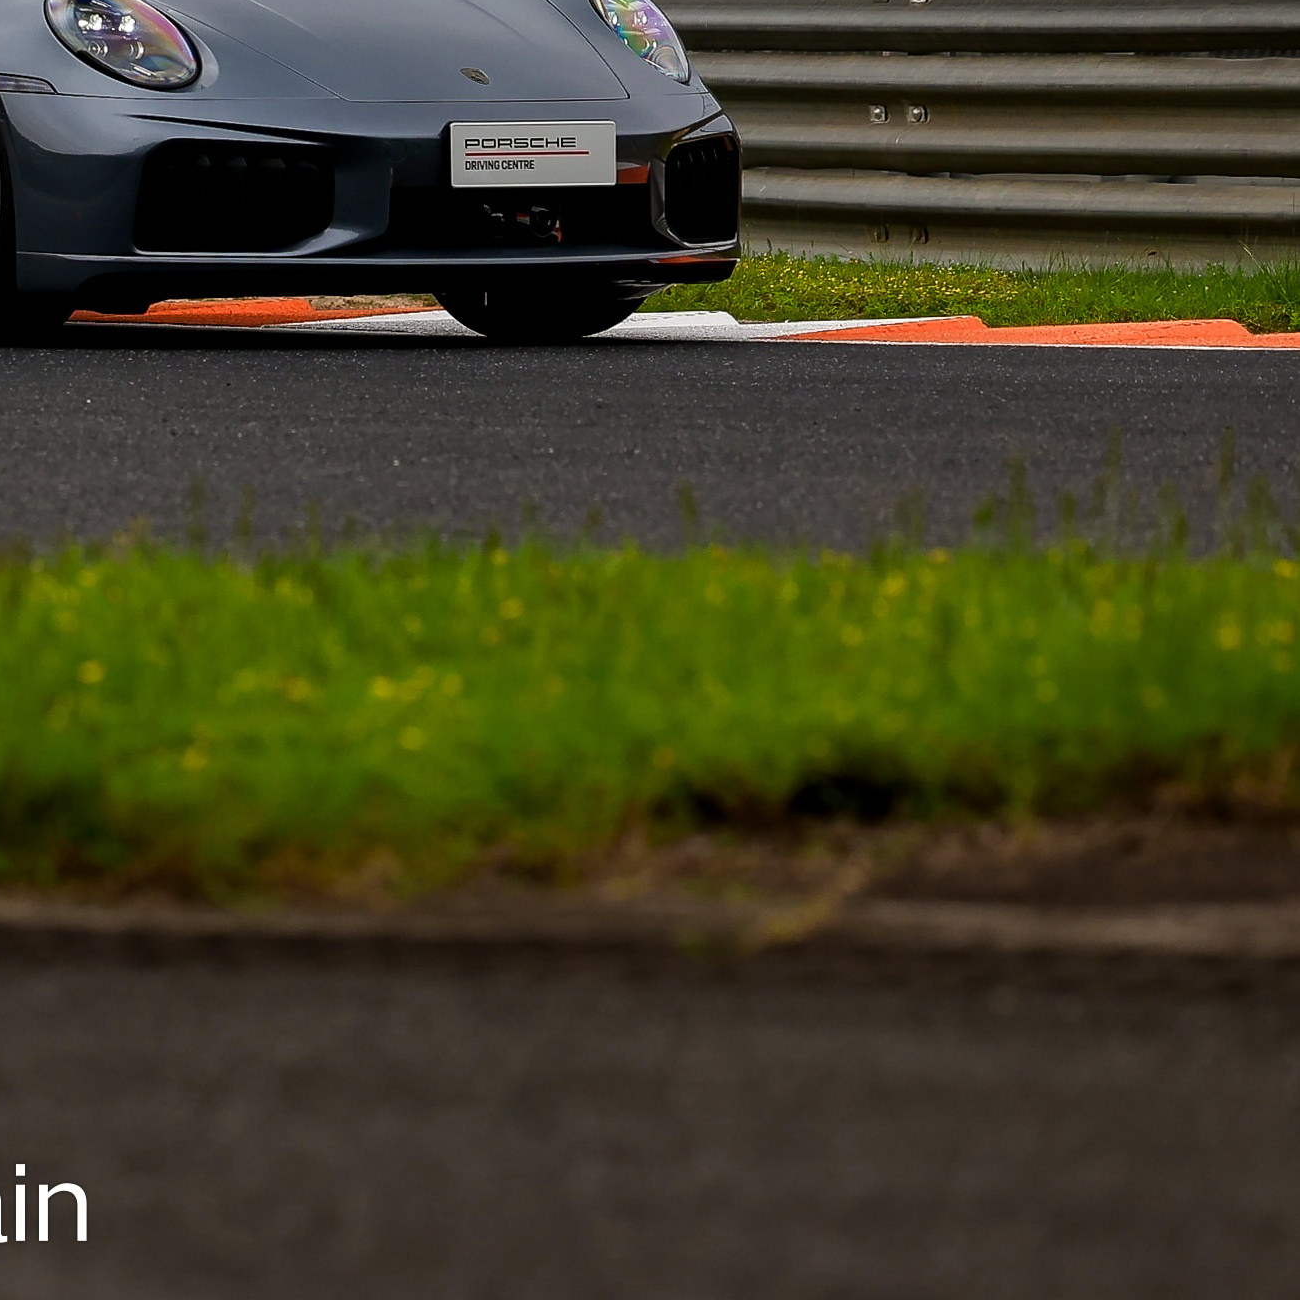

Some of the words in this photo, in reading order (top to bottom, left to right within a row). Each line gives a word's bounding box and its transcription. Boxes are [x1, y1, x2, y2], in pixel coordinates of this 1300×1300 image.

[465, 137, 576, 149] PORSCHE
[465, 160, 500, 170] DRIVING
[502, 160, 535, 170] CENTRE
